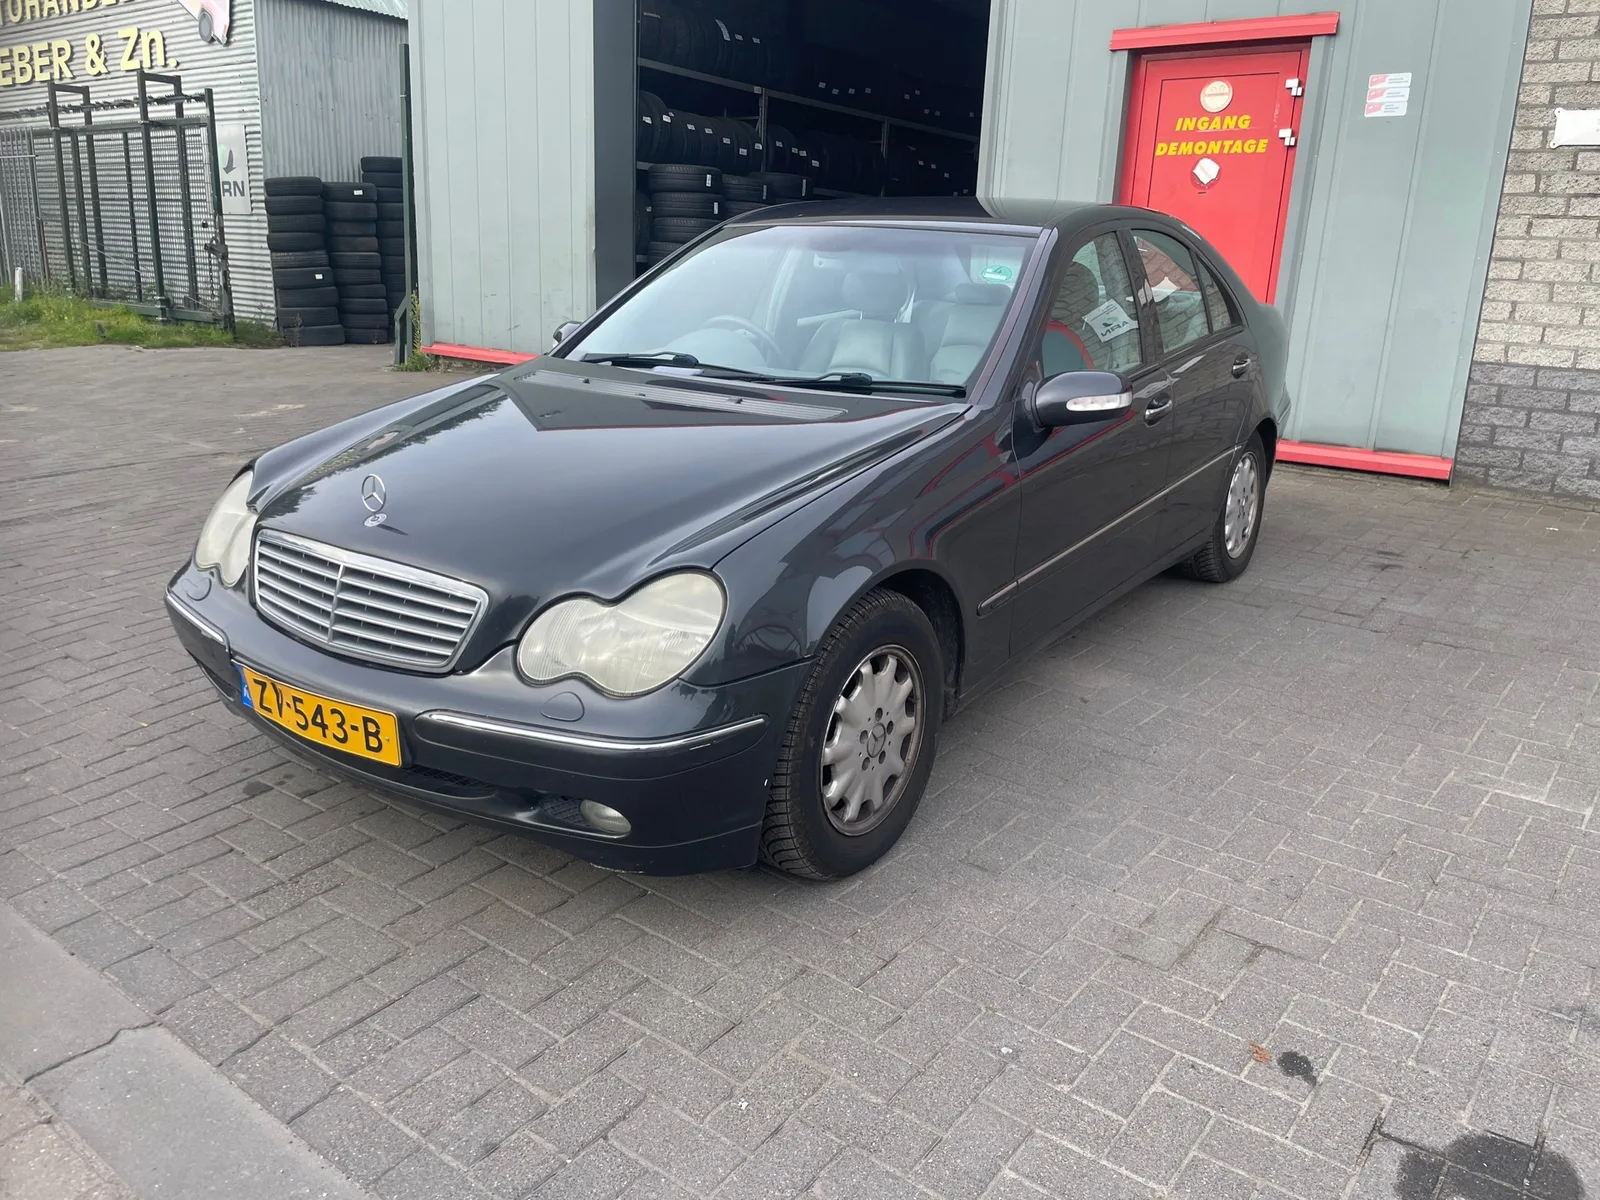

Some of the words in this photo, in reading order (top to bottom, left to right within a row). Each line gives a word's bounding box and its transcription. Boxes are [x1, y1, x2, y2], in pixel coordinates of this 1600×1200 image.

[84, 33, 109, 76] &
[117, 26, 179, 71] Zn.
[1175, 115, 1251, 132] INGANG
[1155, 139, 1268, 156] DEMONTAGE
[252, 678, 383, 753] ZV-543-B
